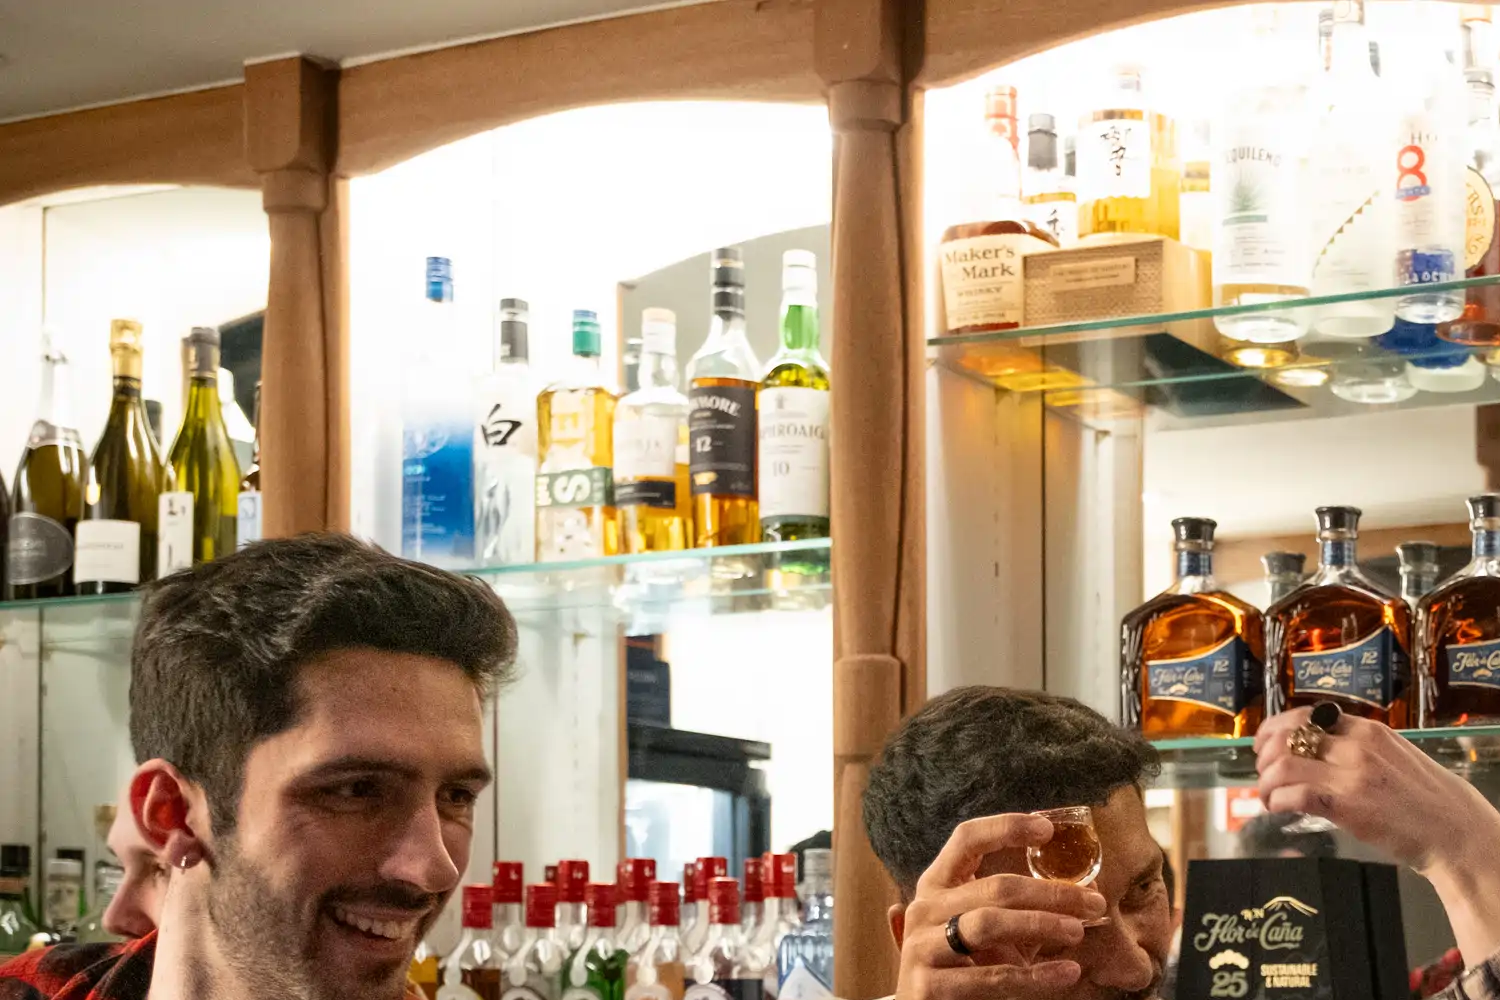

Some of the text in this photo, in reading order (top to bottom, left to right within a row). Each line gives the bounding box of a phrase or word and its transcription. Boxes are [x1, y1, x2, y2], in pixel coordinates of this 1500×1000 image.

[944, 244, 1016, 265] Maker's
[962, 263, 1015, 282] Mark
[480, 403, 524, 448] 白
[695, 435, 712, 453] 12
[773, 460, 791, 478] 10
[1213, 659, 1230, 672] 12
[1360, 650, 1378, 665] 12
[1193, 912, 1245, 952] Flor
[1258, 911, 1304, 950] Caña
[1260, 963, 1318, 977] SUSTAINABLE
[1210, 970, 1248, 998] 25
[1272, 976, 1311, 988] NATURAL
